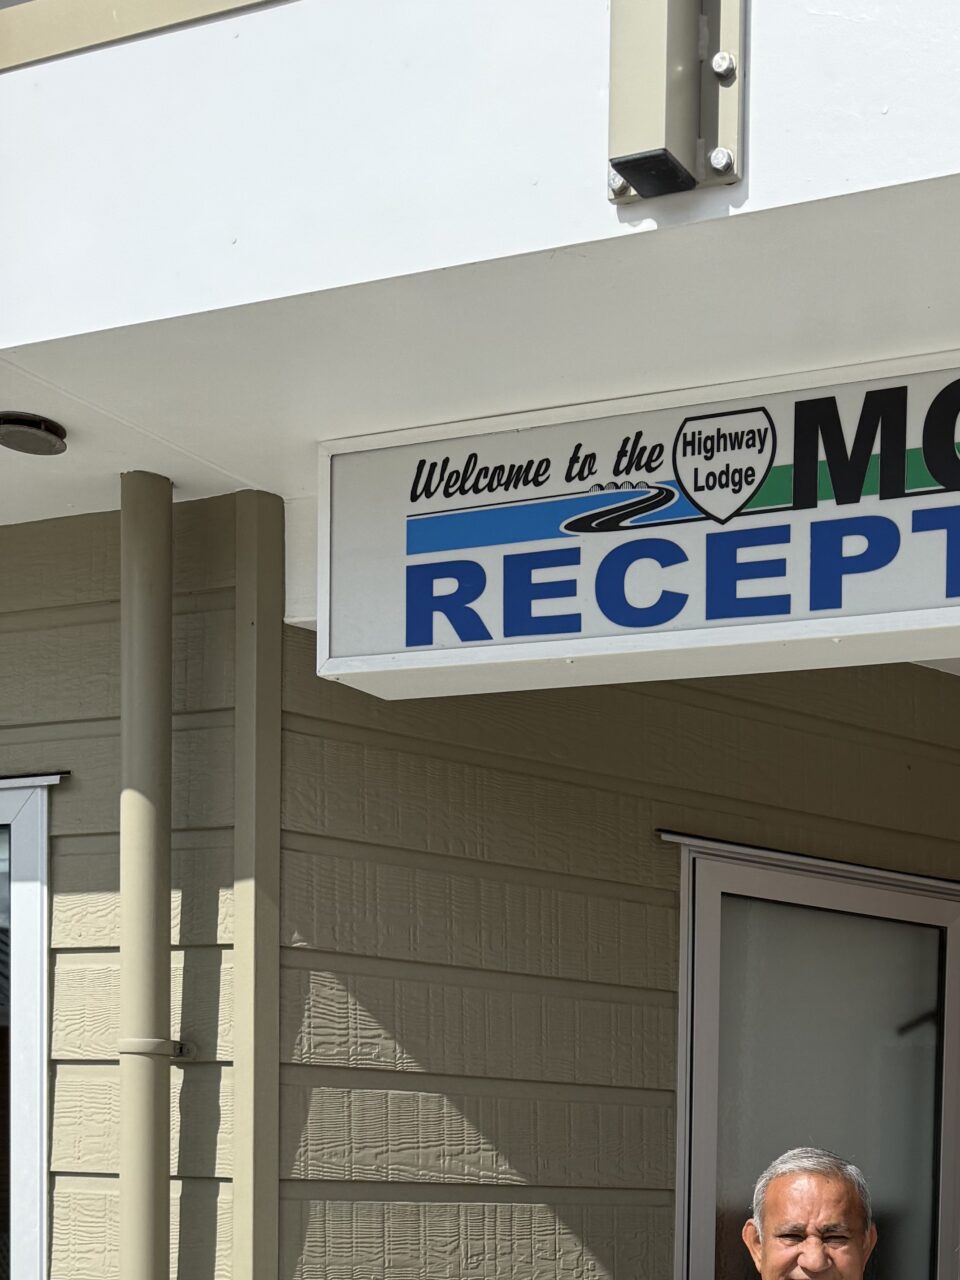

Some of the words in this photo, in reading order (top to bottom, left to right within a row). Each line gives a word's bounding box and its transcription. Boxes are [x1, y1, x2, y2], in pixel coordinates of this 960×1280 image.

[681, 427, 769, 461] Highway
[409, 452, 552, 503] Welcome
[564, 442, 598, 483] to
[612, 430, 665, 477] the
[693, 463, 756, 494] Lodge
